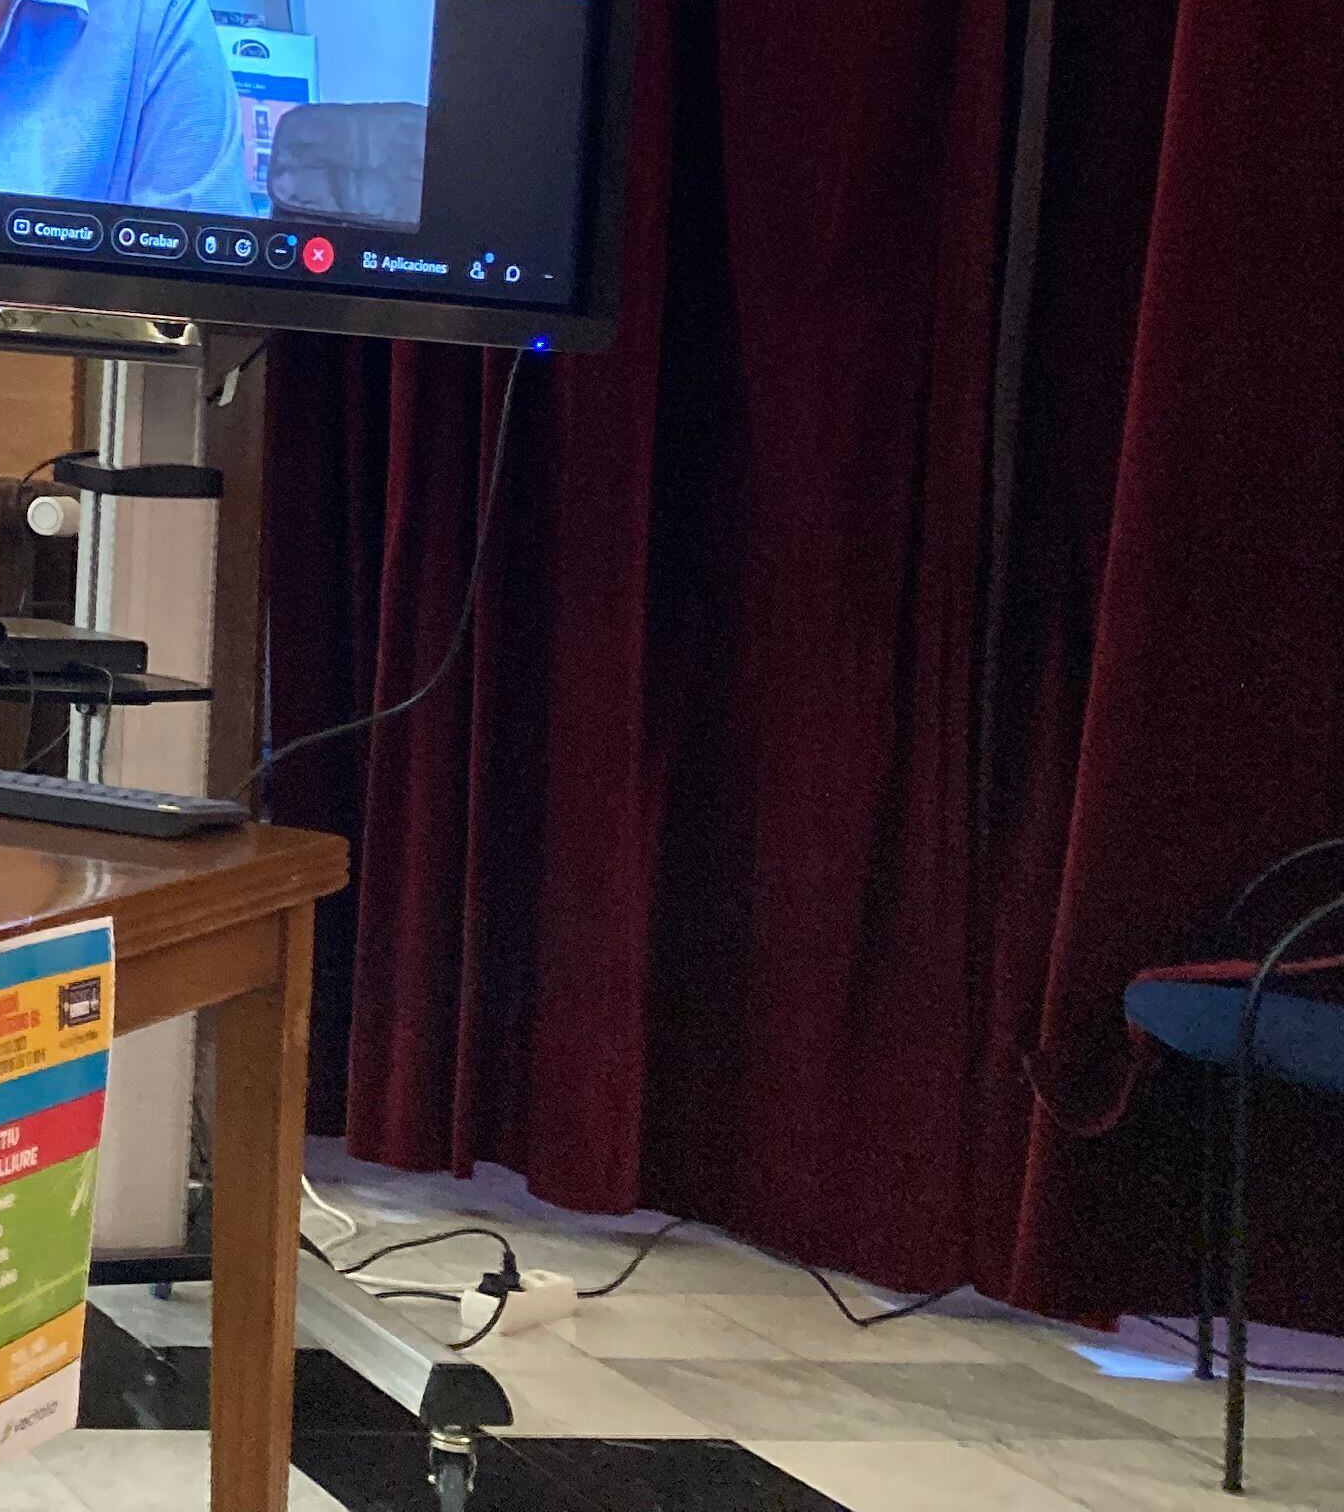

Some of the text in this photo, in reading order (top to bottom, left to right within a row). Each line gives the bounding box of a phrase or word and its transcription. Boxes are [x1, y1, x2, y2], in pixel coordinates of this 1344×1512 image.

[35, 223, 94, 241] Compartir
[140, 232, 179, 248] Grabar
[381, 256, 448, 275] Aplicaciones
